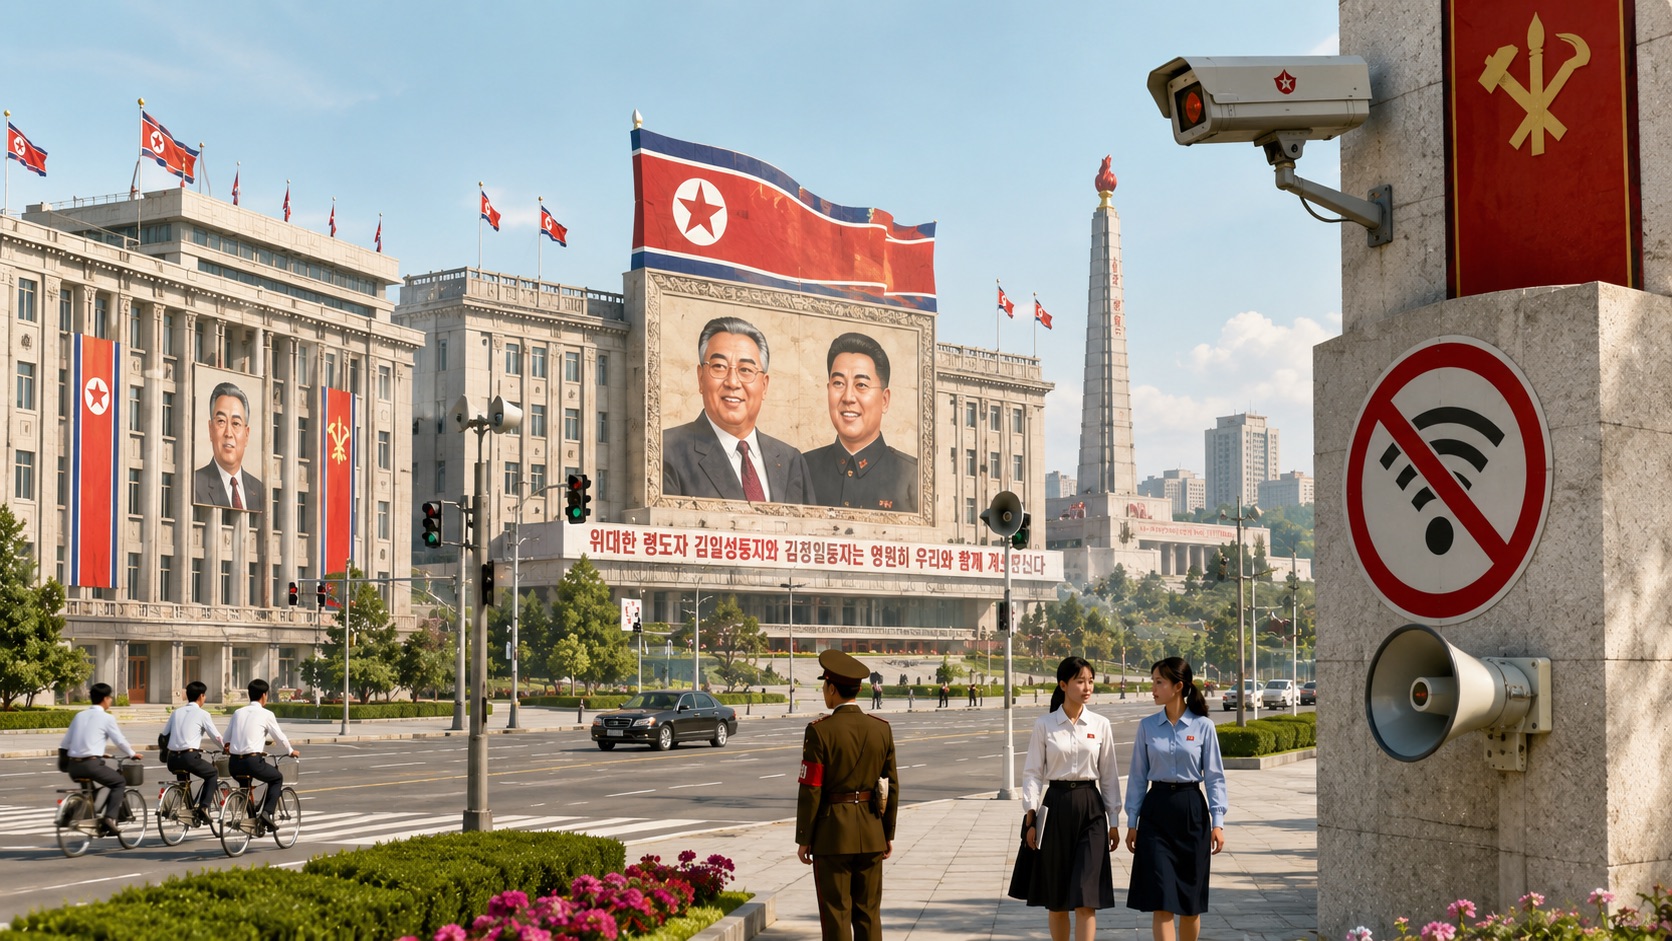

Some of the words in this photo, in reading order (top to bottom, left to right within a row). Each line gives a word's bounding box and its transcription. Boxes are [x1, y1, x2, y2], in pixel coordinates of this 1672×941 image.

[589, 528, 637, 555] 위대한
[643, 531, 689, 558] 령도자
[870, 544, 910, 568] 영원히
[915, 547, 954, 570] 우리와
